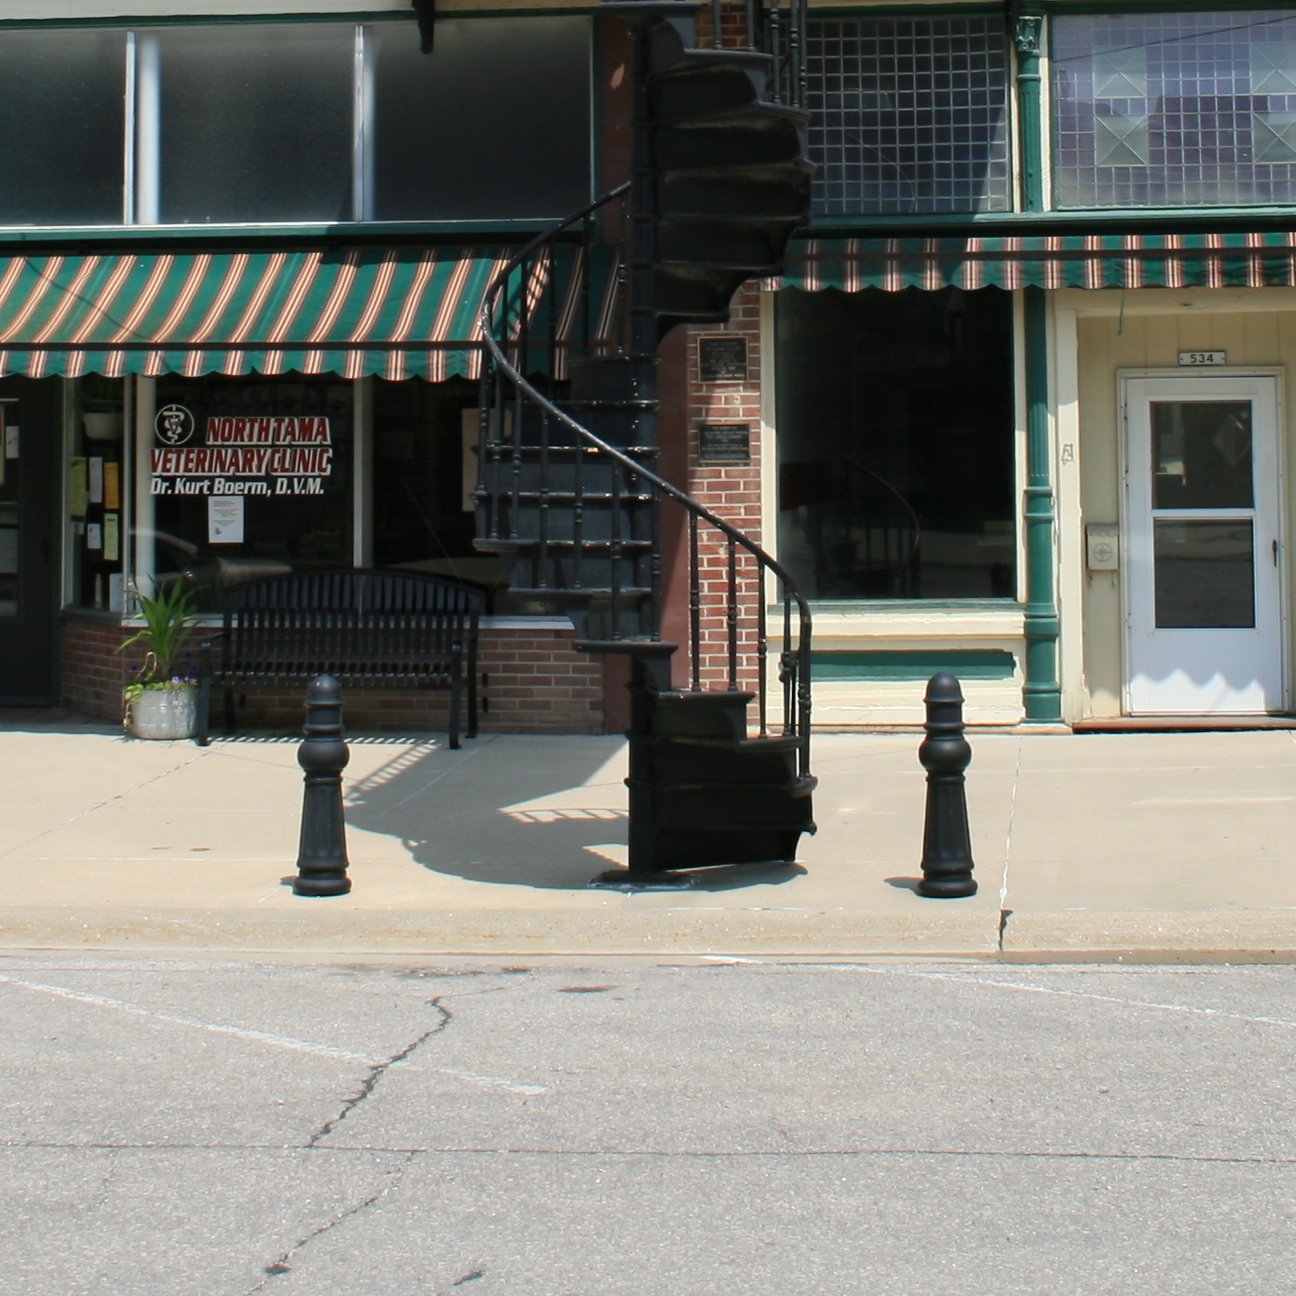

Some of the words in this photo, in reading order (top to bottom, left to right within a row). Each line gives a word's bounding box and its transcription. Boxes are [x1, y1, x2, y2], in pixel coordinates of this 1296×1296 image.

[1190, 353, 1214, 364] 534
[206, 417, 272, 446] NORTH
[271, 417, 332, 445] TAMA
[150, 448, 270, 477] VETERINARY
[268, 447, 334, 476] CLINIC
[150, 478, 172, 495] Dr.
[175, 478, 211, 495] Kurt
[275, 477, 325, 495] D.V.M.
